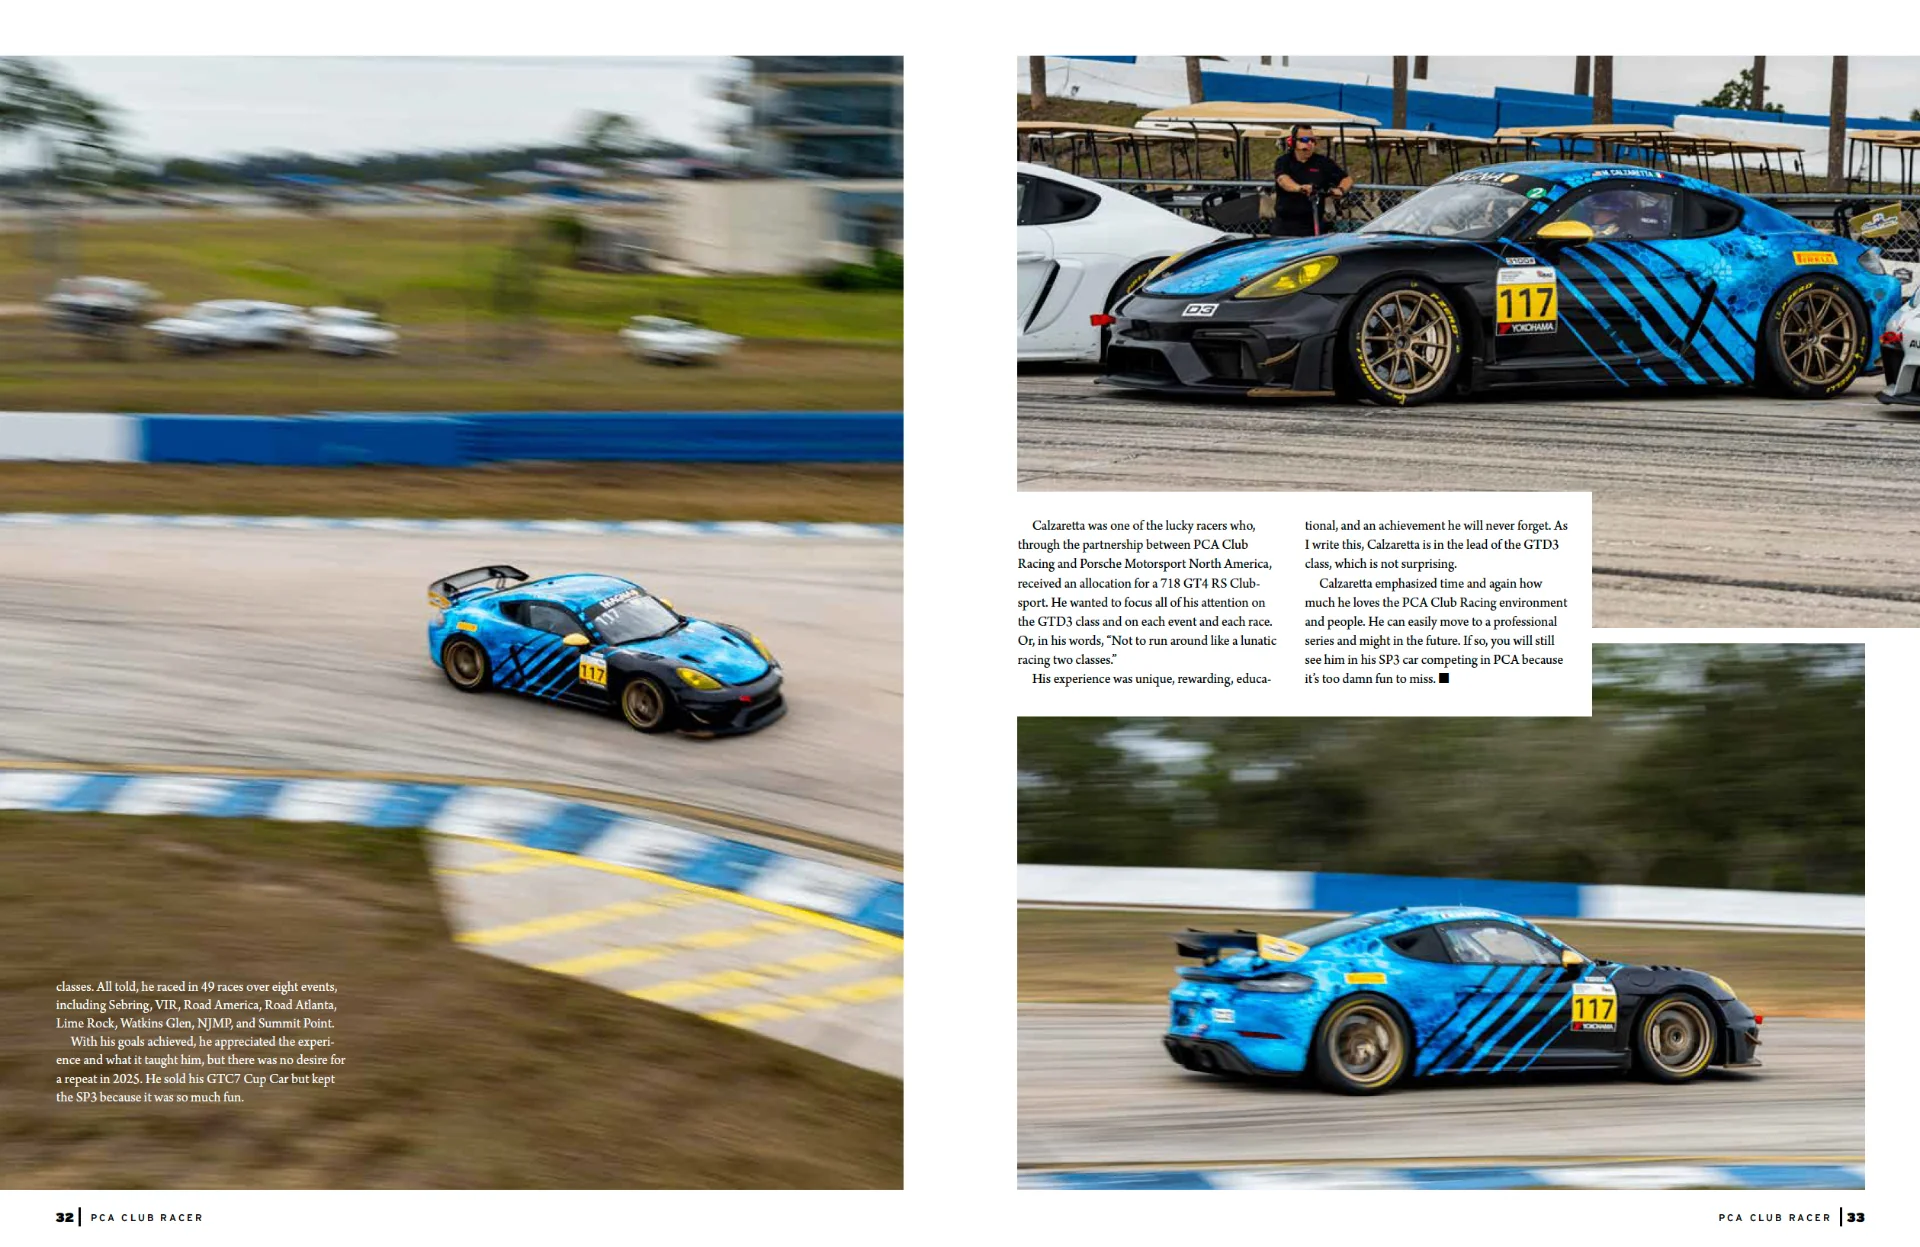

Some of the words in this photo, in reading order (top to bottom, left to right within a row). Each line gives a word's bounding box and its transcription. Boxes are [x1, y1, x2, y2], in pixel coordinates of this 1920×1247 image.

[1532, 187, 1545, 199] 2
[1500, 287, 1554, 319] 117
[1511, 322, 1554, 333] YOKOHAMA
[1032, 519, 1086, 531] Calzaretta
[1087, 523, 1108, 531] was
[1110, 523, 1130, 531] one
[1132, 519, 1145, 531] of
[1146, 519, 1163, 531] the
[1165, 519, 1194, 534] lucky
[1196, 523, 1228, 531] racers
[1230, 519, 1256, 532] who,
[1305, 519, 1339, 532] tional,
[1340, 519, 1361, 531] and
[1363, 523, 1376, 531] an
[1378, 519, 1446, 531] achievement
[1447, 519, 1461, 531] he
[1463, 519, 1483, 531] will
[1485, 523, 1515, 531] never
[1517, 519, 1551, 535] forget.
[1553, 520, 1568, 531] As
[1018, 538, 1060, 554] through
[1063, 538, 1080, 550] the
[1082, 538, 1144, 553] partnership
[1146, 538, 1191, 550] between
[1193, 539, 1220, 550] PCA
[1221, 538, 1249, 550] Club
[1017, 558, 1055, 573] Racing
[1057, 557, 1077, 569] and
[1079, 557, 1122, 569] Porsche
[1124, 558, 1186, 572] Motorsport
[1188, 557, 1222, 569] North
[1223, 558, 1272, 570] America,
[1304, 557, 1332, 571] class,
[1334, 557, 1367, 569] which
[1369, 558, 1378, 569] is
[1380, 559, 1399, 569] not
[1401, 558, 1457, 573] surprising.
[1319, 577, 1373, 589] Calzaretta
[1375, 577, 1437, 592] emphasized
[1440, 578, 1464, 589] time
[1466, 577, 1486, 589] and
[1489, 578, 1517, 593] again
[1519, 577, 1543, 589] how
[595, 607, 620, 627] 117
[1304, 615, 1325, 627] and
[1327, 615, 1366, 630] people.
[1368, 616, 1385, 627] He
[1387, 619, 1406, 627] can
[1407, 615, 1438, 630] easily
[1439, 619, 1469, 627] move
[1472, 617, 1483, 627] to
[1485, 619, 1491, 627] a
[1493, 615, 1557, 630] professional
[1017, 635, 1035, 647] Or,
[1037, 635, 1048, 646] in
[1051, 634, 1067, 646] his
[1068, 634, 1104, 648] words,
[1106, 634, 1133, 646] “Not
[1135, 636, 1147, 646] to
[1148, 638, 1168, 646] run
[1170, 634, 1208, 646] around
[1210, 634, 1230, 646] like
[1232, 638, 1238, 646] a
[1240, 634, 1277, 646] lunatic
[1017, 654, 1051, 669] racing
[1053, 655, 1073, 665] two
[1075, 653, 1117, 665] classes.”
[580, 663, 605, 682] 117
[1304, 672, 1320, 684] it’s
[1322, 674, 1340, 684] too
[1342, 672, 1373, 684] damn
[1375, 672, 1393, 684] fun
[1396, 674, 1407, 684] to
[1409, 673, 1436, 684] miss.
[56, 980, 94, 992] classes.
[95, 980, 113, 992] All
[115, 980, 139, 994] told,
[141, 980, 155, 992] he
[156, 980, 186, 992] raced
[187, 981, 199, 992] in
[200, 981, 215, 993] 49
[217, 984, 244, 992] races
[246, 984, 270, 992] over
[271, 980, 299, 996] eight
[300, 982, 338, 993] events,
[56, 998, 107, 1014] including
[108, 998, 153, 1014] Sebring,
[154, 999, 181, 1012] VIR,
[183, 998, 212, 1010] Road
[213, 999, 262, 1012] America,
[264, 998, 293, 1010] Road
[294, 998, 337, 1012] Atlanta,
[1575, 997, 1614, 1020] 117
[56, 1017, 84, 1028] Lime
[87, 1017, 118, 1031] Rock,
[120, 1017, 163, 1028] Watkins
[165, 1017, 195, 1030] Glen,
[197, 1017, 234, 1032] NJMP,
[236, 1017, 256, 1028] and
[258, 1017, 301, 1028] Summit
[303, 1017, 335, 1028] Point.
[70, 1035, 98, 1047] With
[100, 1035, 116, 1047] his
[117, 1035, 145, 1051] goals
[147, 1035, 197, 1048] achieved,
[198, 1035, 212, 1047] he
[214, 1035, 276, 1050] appreciated
[278, 1035, 296, 1047] the
[297, 1036, 334, 1050] experi-
[56, 1076, 62, 1084] a
[64, 1075, 98, 1088] repeat
[100, 1074, 110, 1084] in
[113, 1073, 143, 1085] 2025.
[145, 1073, 162, 1084] He
[163, 1072, 186, 1084] sold
[188, 1072, 204, 1084] his
[206, 1073, 241, 1084] GTC7
[243, 1073, 267, 1088] Cup
[269, 1073, 289, 1084] Car
[291, 1073, 310, 1084] but
[311, 1072, 336, 1088] kept
[56, 1091, 74, 1102] the
[76, 1091, 98, 1103] SP3
[99, 1091, 142, 1102] because
[143, 1092, 152, 1102] it
[153, 1094, 174, 1102] was
[176, 1094, 189, 1102] so
[190, 1091, 221, 1102] much
[223, 1091, 244, 1102] fun.
[55, 1212, 74, 1223] 32
[90, 1213, 115, 1222] PCA
[121, 1213, 154, 1222] CLUB
[160, 1213, 202, 1222] RACER
[1718, 1213, 1743, 1222] PCA
[1749, 1213, 1782, 1222] CLUB
[1789, 1213, 1830, 1222] RACER
[1846, 1212, 1865, 1223] 33
